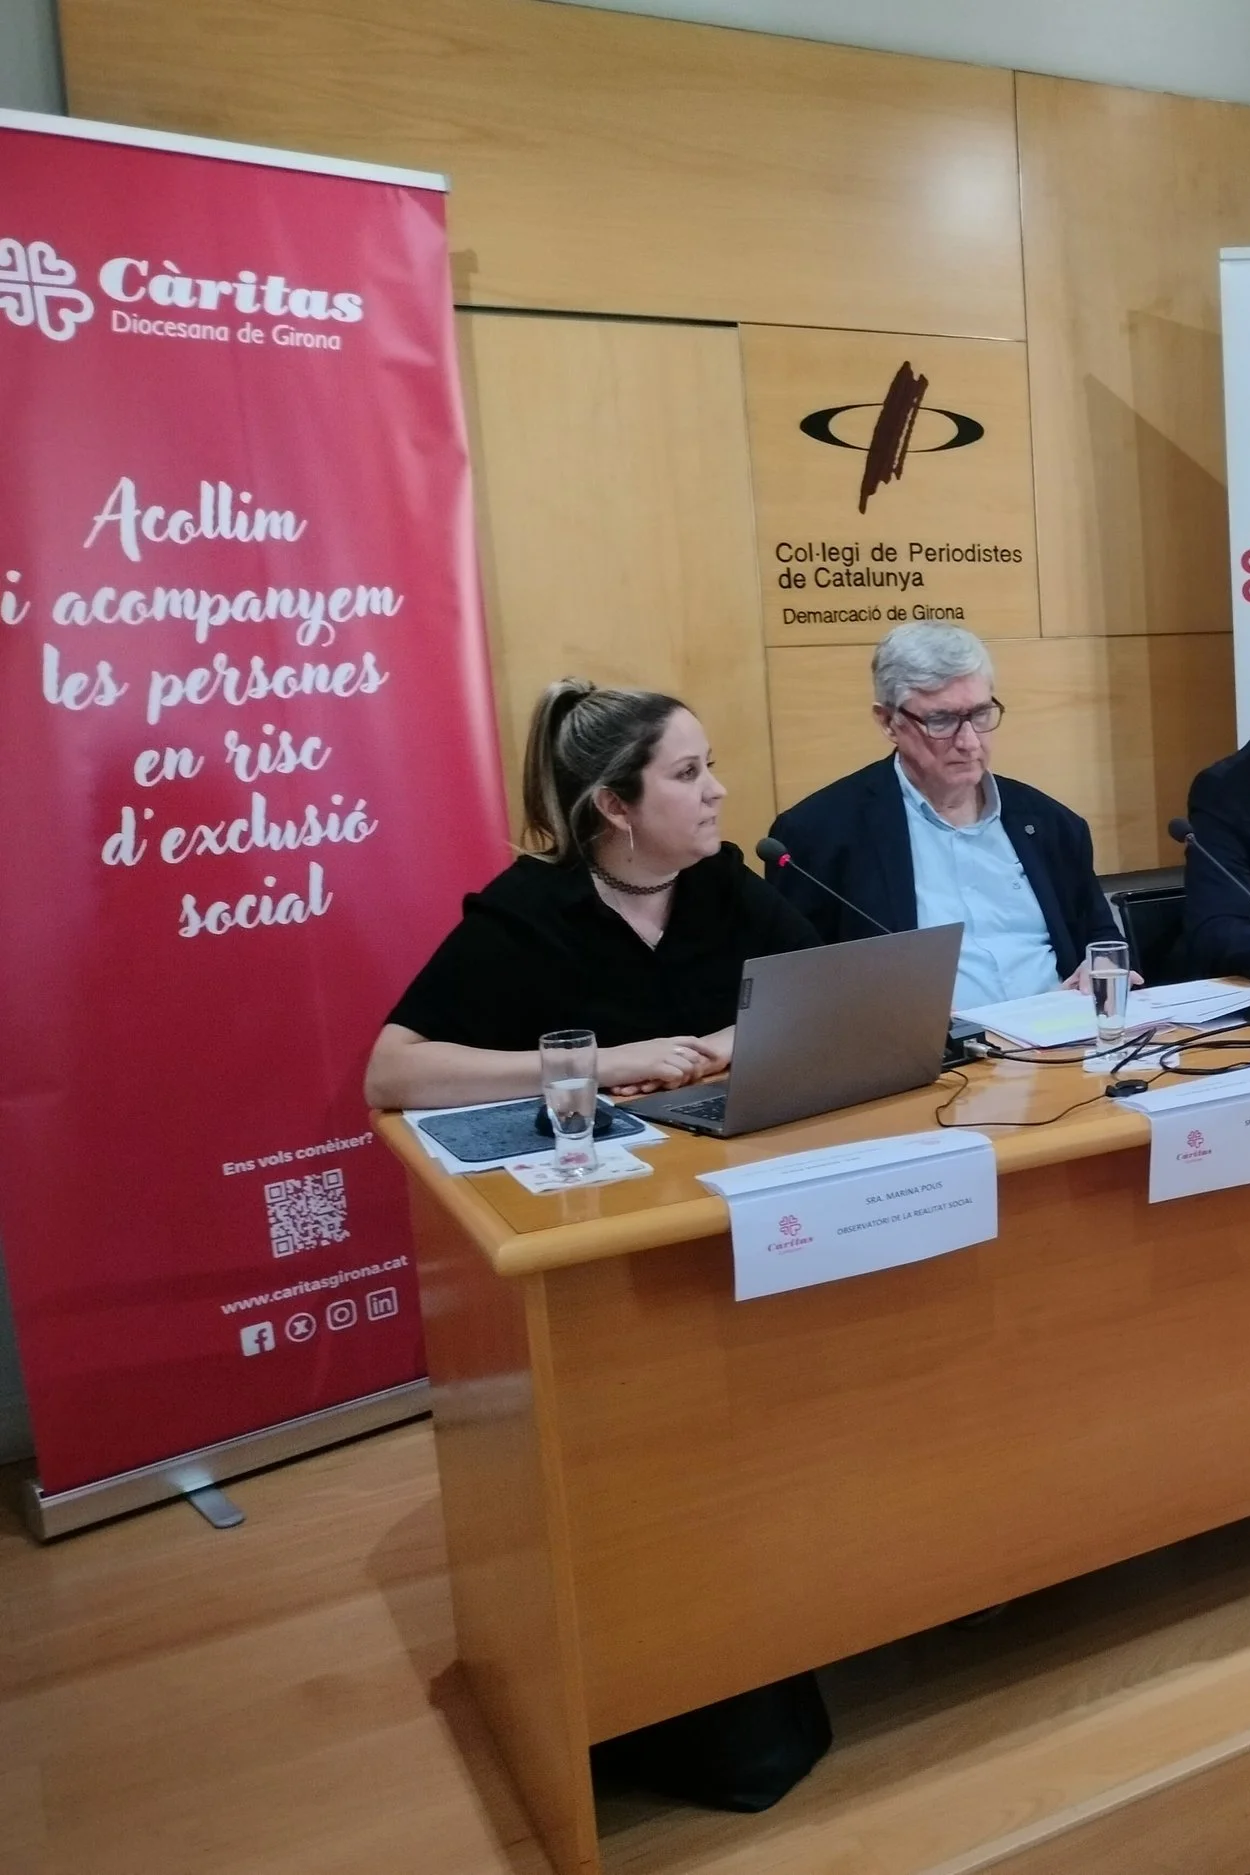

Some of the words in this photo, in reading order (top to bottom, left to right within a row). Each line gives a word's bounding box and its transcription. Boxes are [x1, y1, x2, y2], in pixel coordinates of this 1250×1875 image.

[99, 257, 364, 322] Càritas
[111, 310, 229, 343] Diocesana
[236, 322, 264, 344] de
[271, 325, 342, 351] Girona
[83, 476, 307, 562] Acollim
[776, 542, 860, 567] Col·legi
[871, 543, 898, 562] de
[909, 542, 1023, 563] Periodistes
[778, 568, 807, 589] de
[814, 566, 925, 591] Catalunya
[0, 570, 30, 625] i
[52, 584, 404, 647] acompanyem
[783, 606, 882, 625] Demarcació
[887, 605, 907, 620] de
[912, 605, 965, 621] Girona
[43, 643, 129, 710] les
[147, 652, 390, 725] persones
[134, 746, 204, 787] en
[225, 723, 332, 782] risc
[178, 861, 333, 938] social
[222, 1159, 256, 1176] Ens
[258, 1149, 293, 1168] vols
[295, 1132, 374, 1160] conèixer?
[836, 1215, 890, 1236] OBSERVATORI
[891, 1213, 901, 1223] DE
[902, 1211, 913, 1220] LA
[913, 1203, 948, 1217] REALITAT
[948, 1197, 974, 1209] SOCIAL
[886, 1186, 920, 1201] MARINA
[920, 1181, 943, 1194] POUS
[220, 1255, 409, 1315] www.caritasgirona.cat
